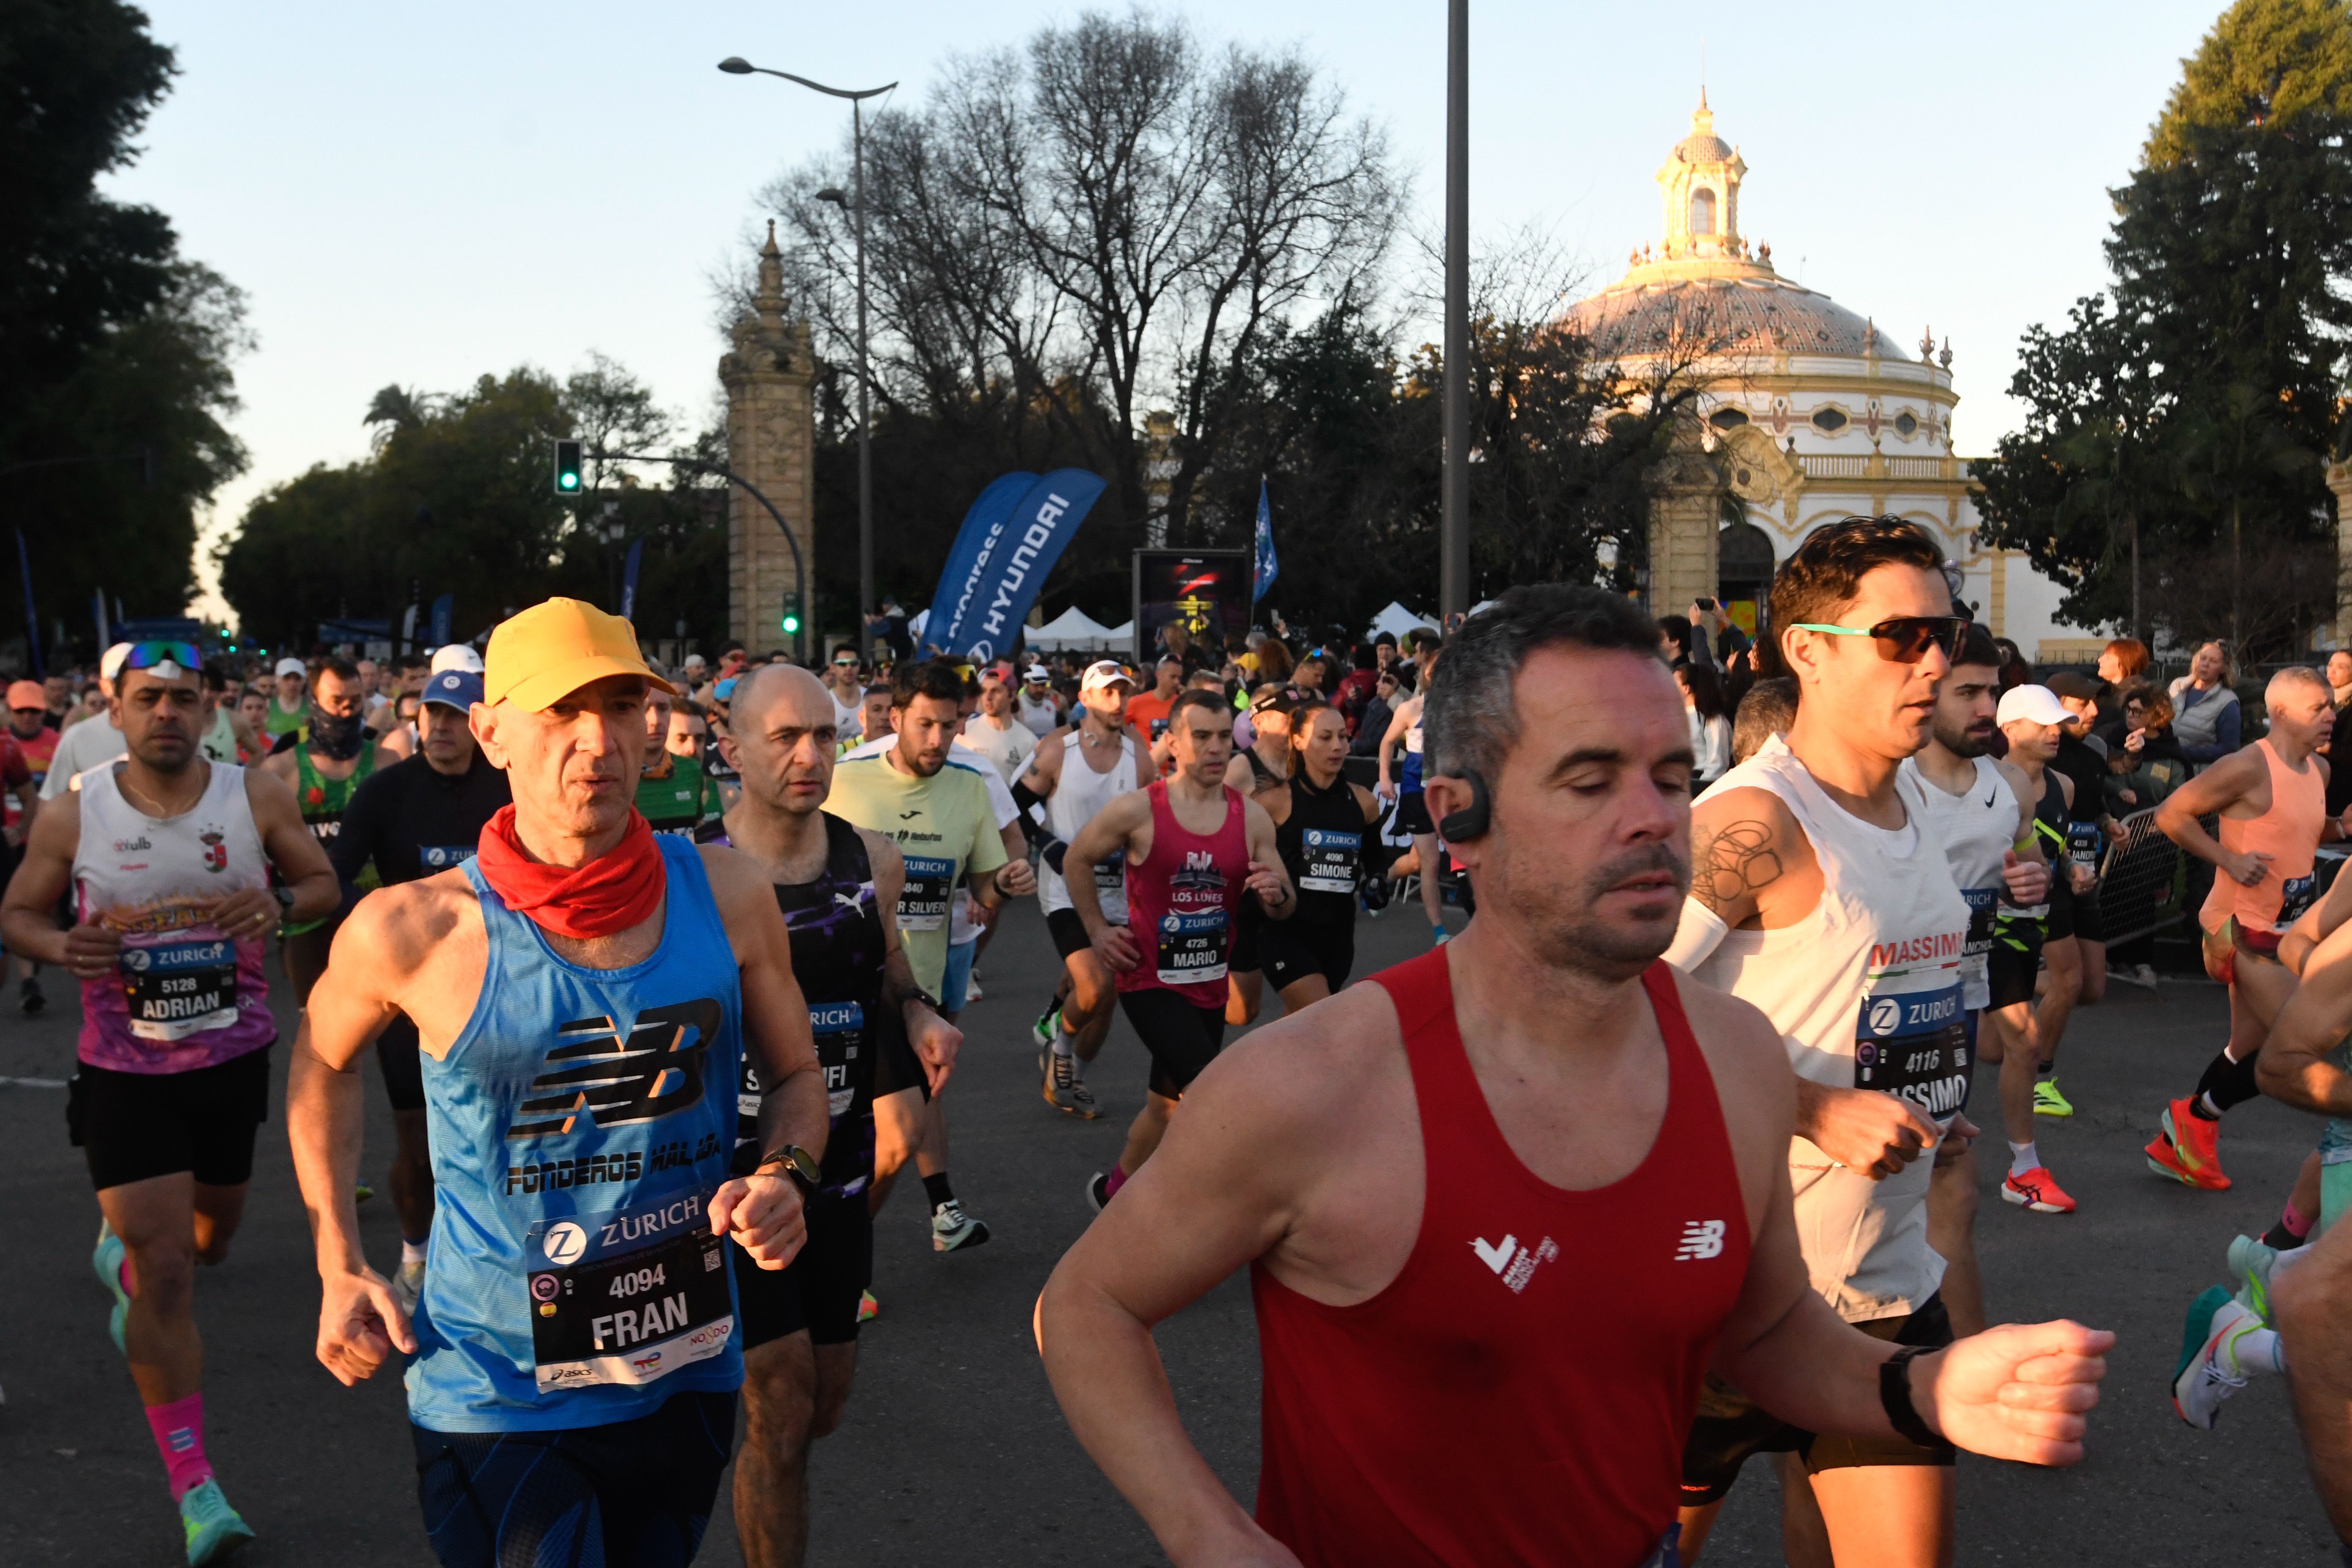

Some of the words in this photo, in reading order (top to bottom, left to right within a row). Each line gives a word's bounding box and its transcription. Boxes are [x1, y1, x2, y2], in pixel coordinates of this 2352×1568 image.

[982, 493, 1070, 636] HYUNDAI
[949, 522, 1004, 638] roress
[1326, 835, 1357, 845] ZURICH
[1325, 852, 1344, 863] 4090
[904, 860, 946, 872] ZURICH
[1310, 863, 1353, 879] SIMONE
[903, 882, 924, 893] 840
[1172, 892, 1192, 902] LOS
[1964, 894, 1991, 905] RICH
[1185, 916, 1224, 928] ZURICH
[1186, 938, 1208, 949] 4726
[158, 947, 222, 965] ZURICH
[1173, 950, 1217, 967] MARIO
[161, 977, 197, 993] 5128
[142, 991, 220, 1019] ADRIAN
[1907, 995, 1956, 1025] ZURICH
[1906, 1048, 1940, 1073] 4116
[601, 1195, 700, 1247] ZURICH
[609, 1263, 667, 1298] 4094
[592, 1292, 689, 1350] FRAN
